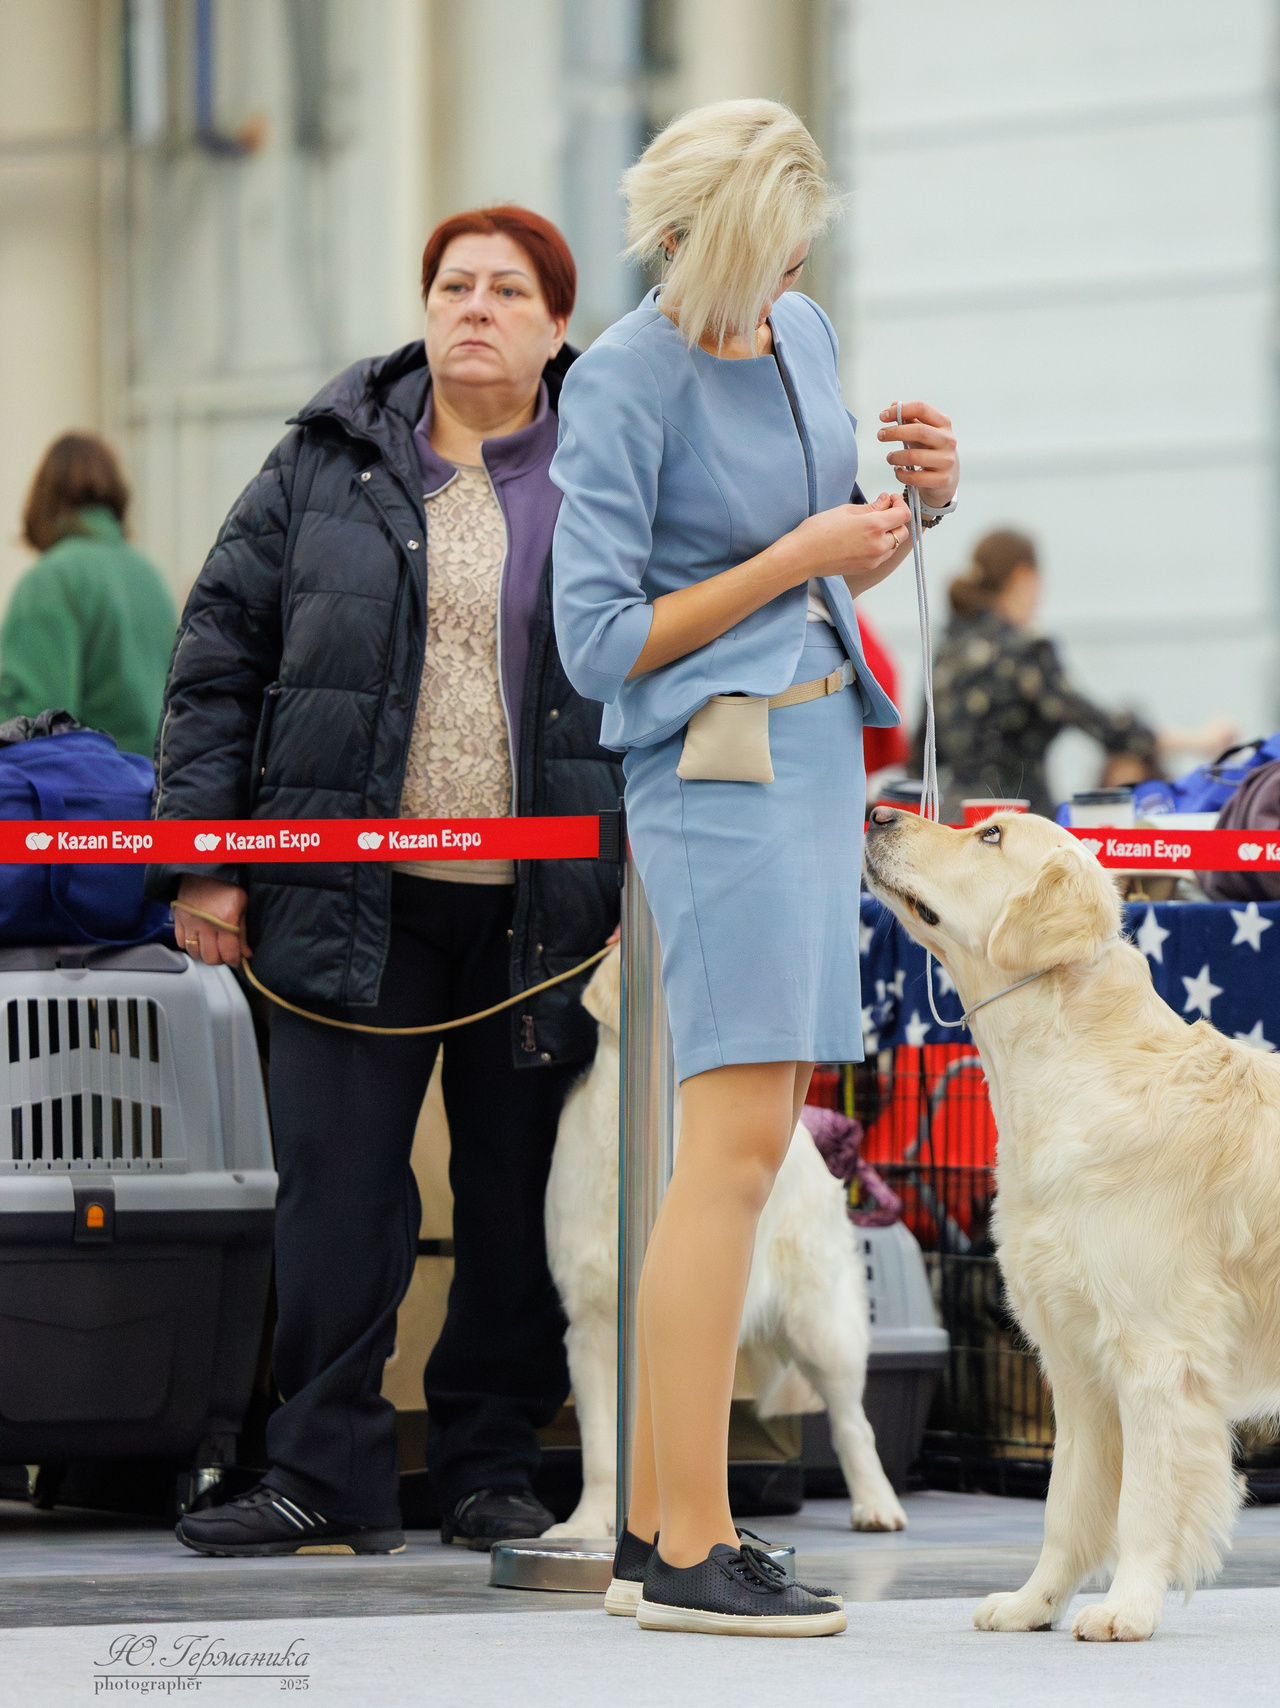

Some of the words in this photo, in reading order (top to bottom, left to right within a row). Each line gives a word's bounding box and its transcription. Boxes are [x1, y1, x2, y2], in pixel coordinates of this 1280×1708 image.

[57, 832, 107, 850] Kazan
[112, 831, 153, 854] Expo
[226, 832, 276, 851] Kazan
[279, 829, 320, 852] Expo
[388, 831, 438, 850] Kazan
[441, 829, 482, 852] Expo
[1106, 838, 1151, 858] Kazan
[1154, 839, 1191, 862] Expo
